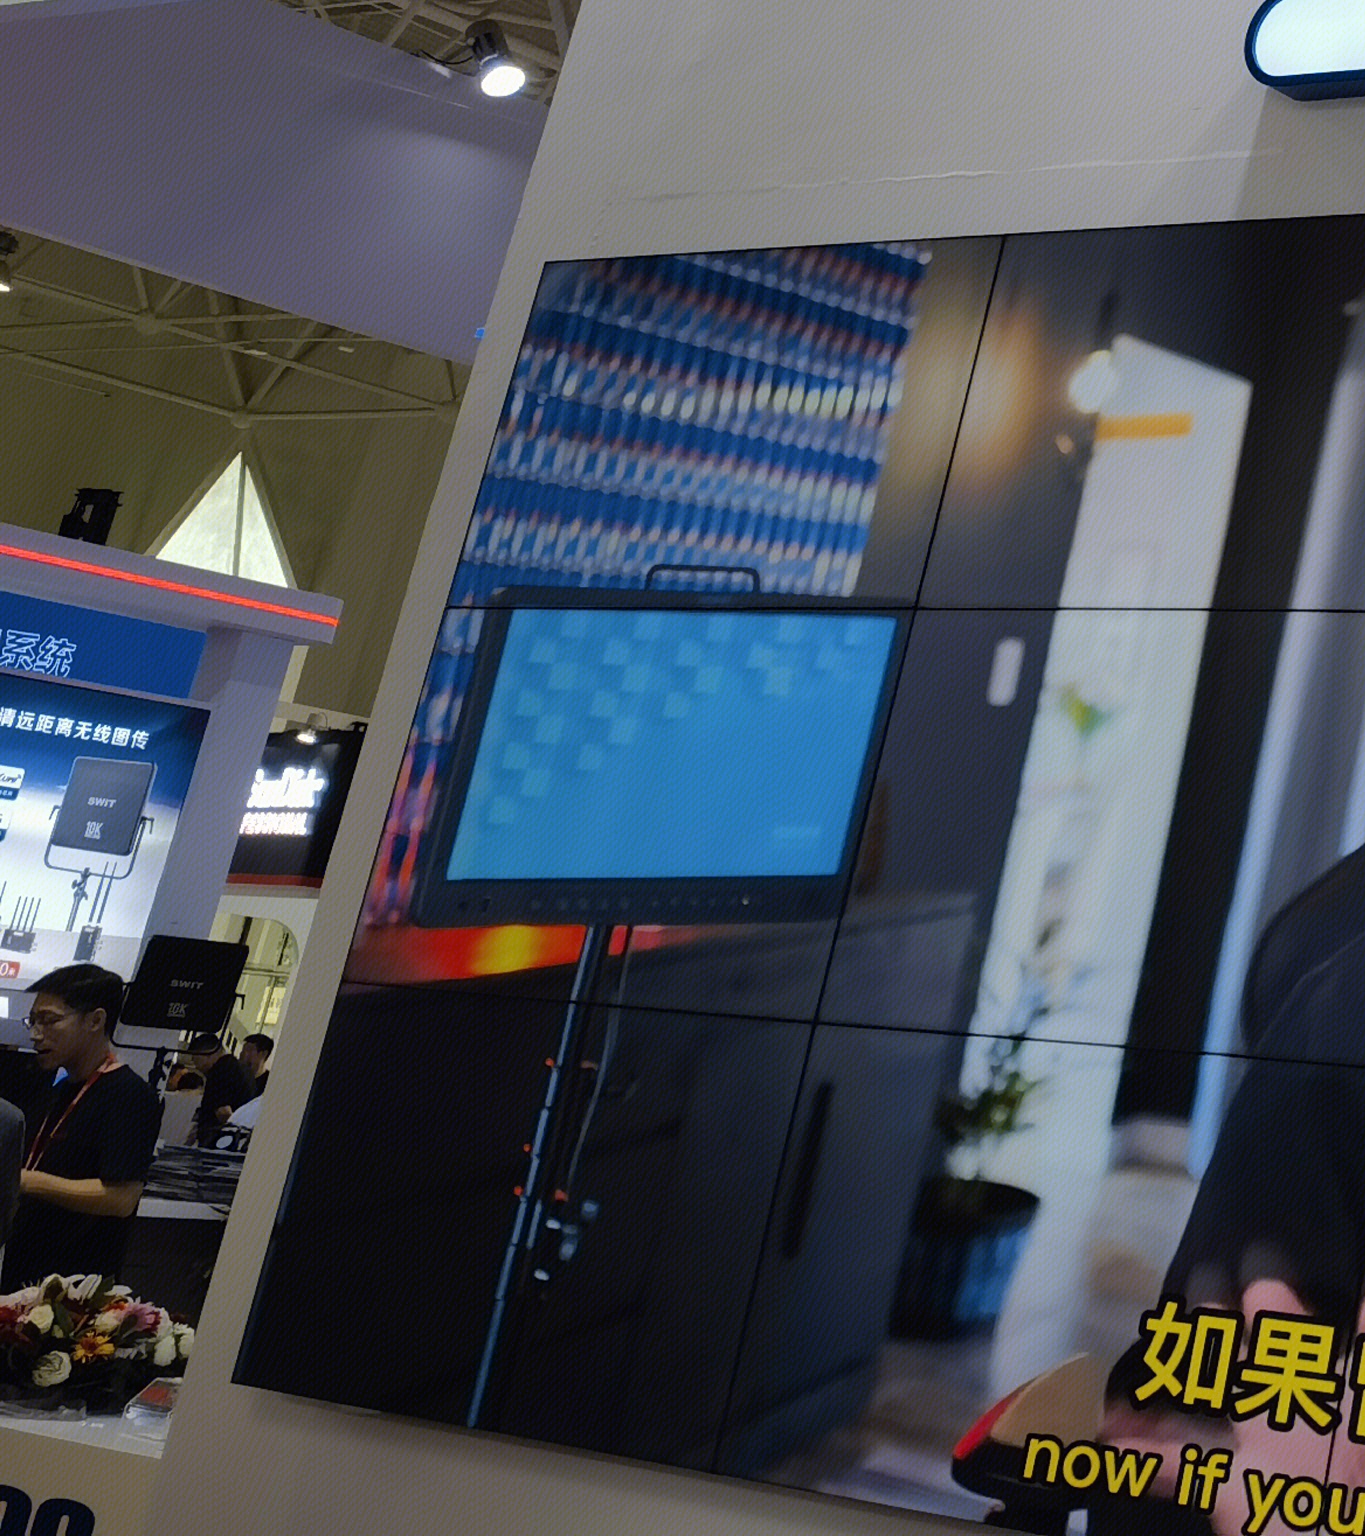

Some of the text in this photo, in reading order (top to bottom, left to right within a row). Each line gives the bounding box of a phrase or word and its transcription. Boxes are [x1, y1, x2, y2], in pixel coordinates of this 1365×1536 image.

[0, 629, 77, 678] 系统
[87, 796, 117, 808] SWIT
[170, 978, 204, 990] SWIT
[1022, 1436, 1158, 1498] now
[1178, 1449, 1229, 1510] if
